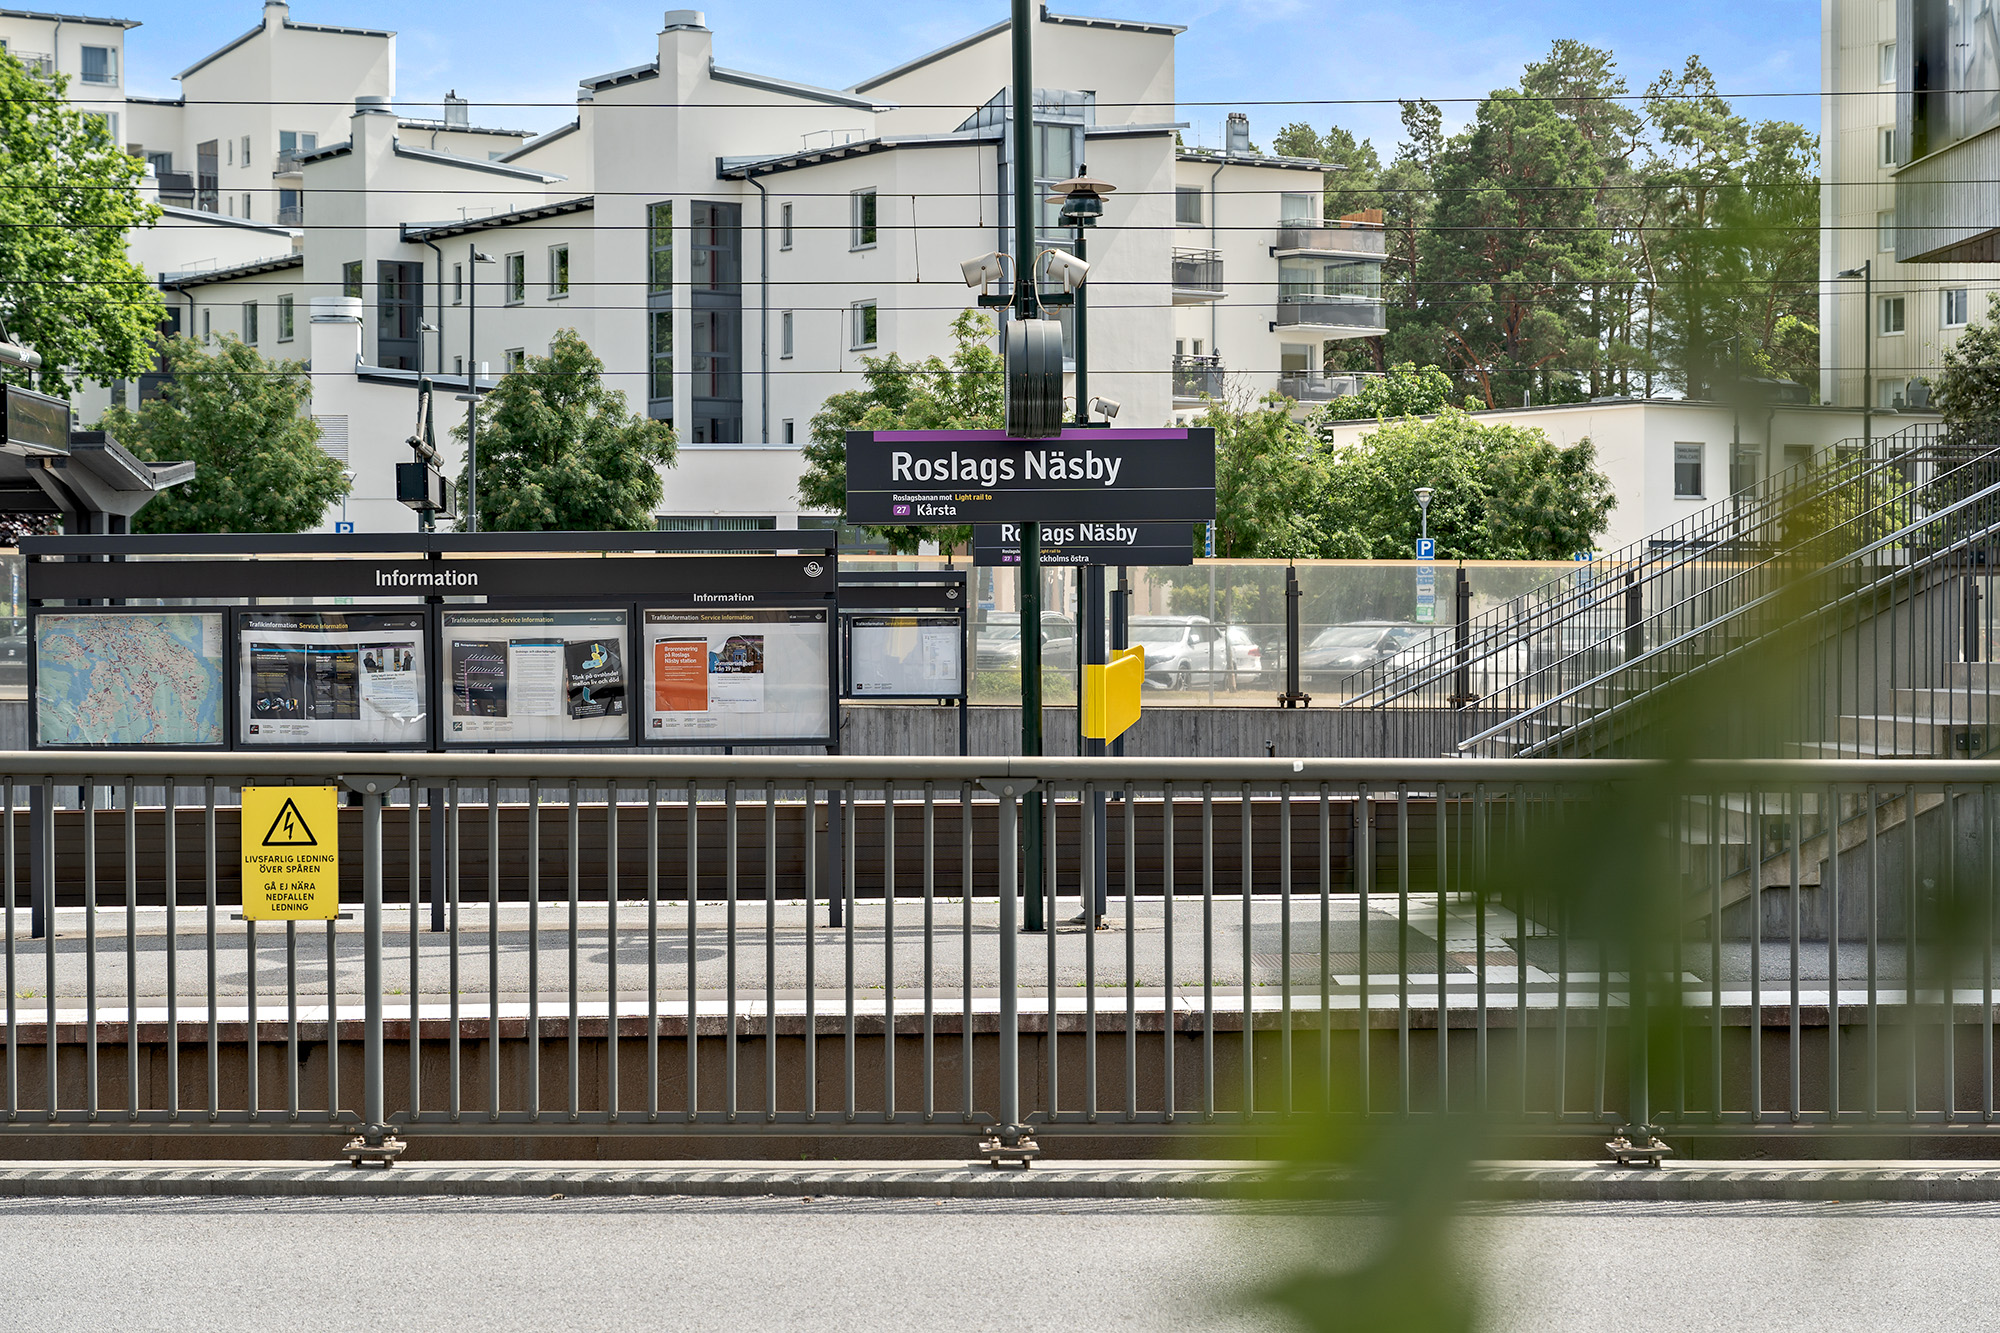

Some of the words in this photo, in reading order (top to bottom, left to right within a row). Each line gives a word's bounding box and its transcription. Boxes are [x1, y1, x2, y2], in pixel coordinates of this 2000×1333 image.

[891, 451, 1015, 487] Roslags
[1024, 450, 1122, 486] Näsby
[892, 494, 938, 502] Roslagsbanan
[955, 494, 972, 502] Light
[896, 506, 907, 514] 27
[917, 504, 957, 516] Kårsta
[1001, 523, 1074, 546] Rags
[1080, 523, 1138, 546] Näsby
[1421, 541, 1432, 556] P
[1070, 554, 1090, 563] östra
[376, 569, 479, 586] Information
[693, 593, 755, 602] Information
[249, 621, 298, 629] Trafikinformation
[245, 855, 294, 863] LIVSFARLIG
[296, 855, 335, 863] LEDNING
[259, 864, 283, 873] ÖVER
[286, 863, 320, 873] SPÅREN
[264, 881, 276, 891] GÅ
[291, 881, 316, 890] NÄRA
[266, 893, 315, 901] NEDFALLEN
[271, 903, 309, 911] LEDNING
